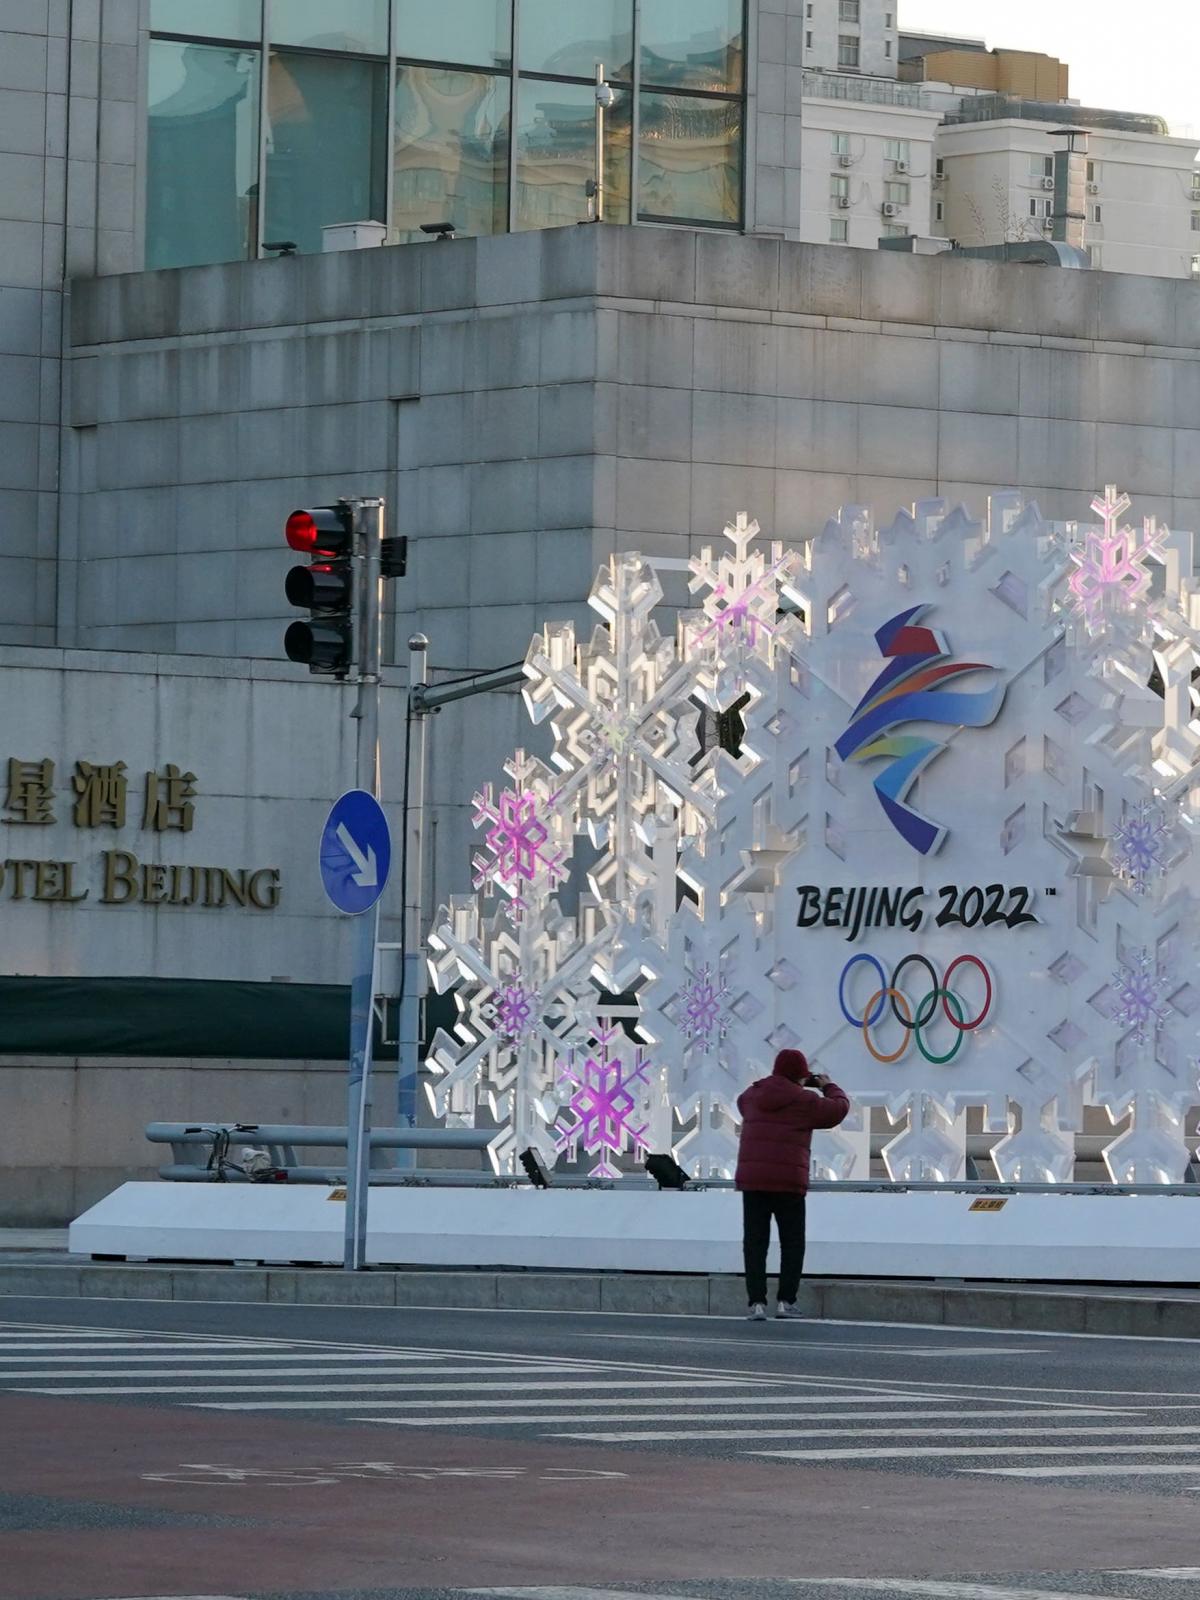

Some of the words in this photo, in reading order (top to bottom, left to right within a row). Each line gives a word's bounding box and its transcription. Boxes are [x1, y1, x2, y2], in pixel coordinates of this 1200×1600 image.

[0, 859, 89, 901] TEL
[100, 850, 282, 909] BEIJING
[796, 885, 923, 941] BEIJING
[936, 884, 1037, 928] 2022
